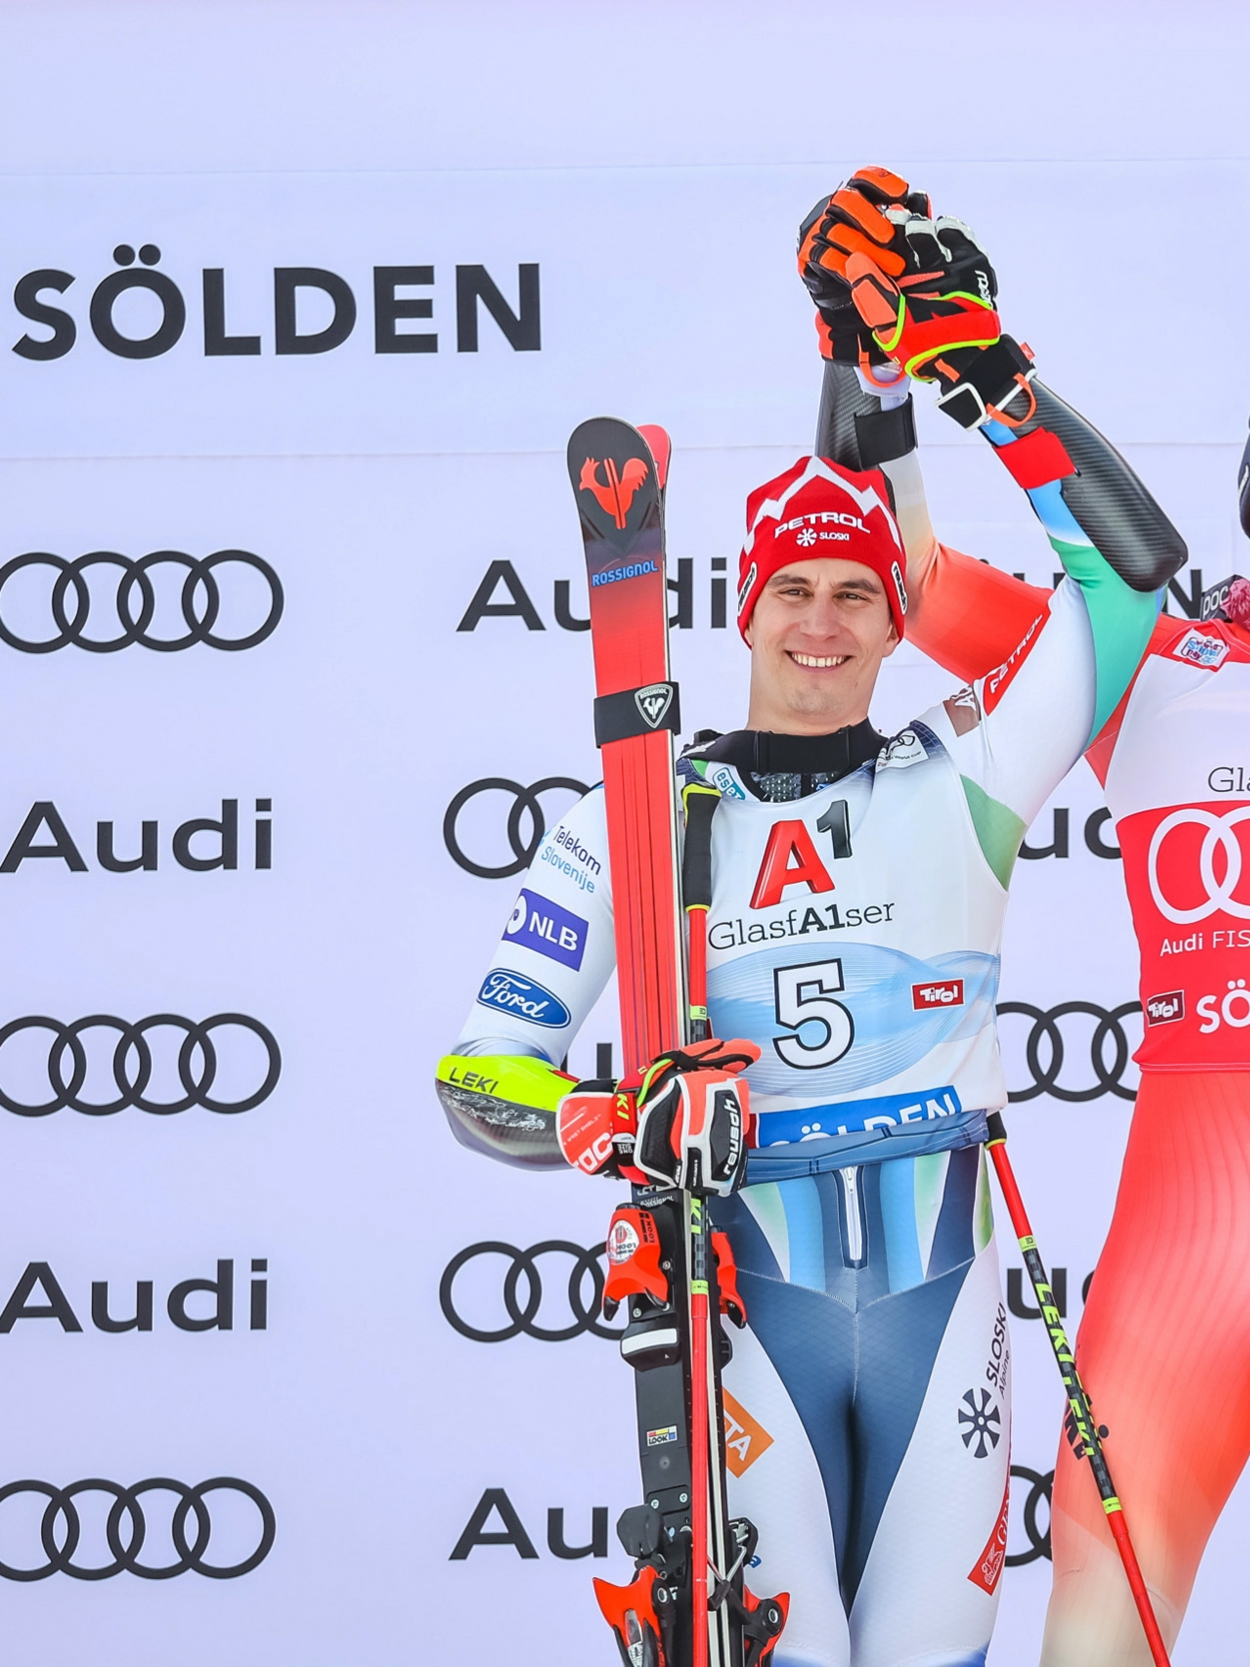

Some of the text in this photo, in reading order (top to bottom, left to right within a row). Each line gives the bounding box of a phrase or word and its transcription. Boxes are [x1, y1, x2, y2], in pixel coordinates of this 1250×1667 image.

[11, 244, 541, 361] SÖLDEN
[774, 511, 871, 540] PETROL
[819, 531, 850, 542] SLOSKI
[592, 560, 659, 587] ROSSIGNOL
[0, 798, 273, 873] Audi
[553, 825, 602, 876] Telekom
[749, 799, 853, 911] A1
[540, 845, 596, 894] Slovenije
[528, 910, 579, 952] NLB
[708, 902, 896, 951] GlasfA1ser
[1160, 933, 1204, 957] Audi
[480, 970, 552, 1020] Ford
[772, 957, 855, 1071] 5
[919, 984, 959, 1003] Tirol
[1147, 997, 1179, 1019] Tirol
[448, 1066, 500, 1094] LEKI
[723, 1098, 740, 1176] reusch
[0, 1258, 268, 1334] Audi
[985, 1301, 1006, 1388] SLOSKI
[1034, 1282, 1076, 1364] LEKI
[648, 1434, 668, 1446] LOOK
